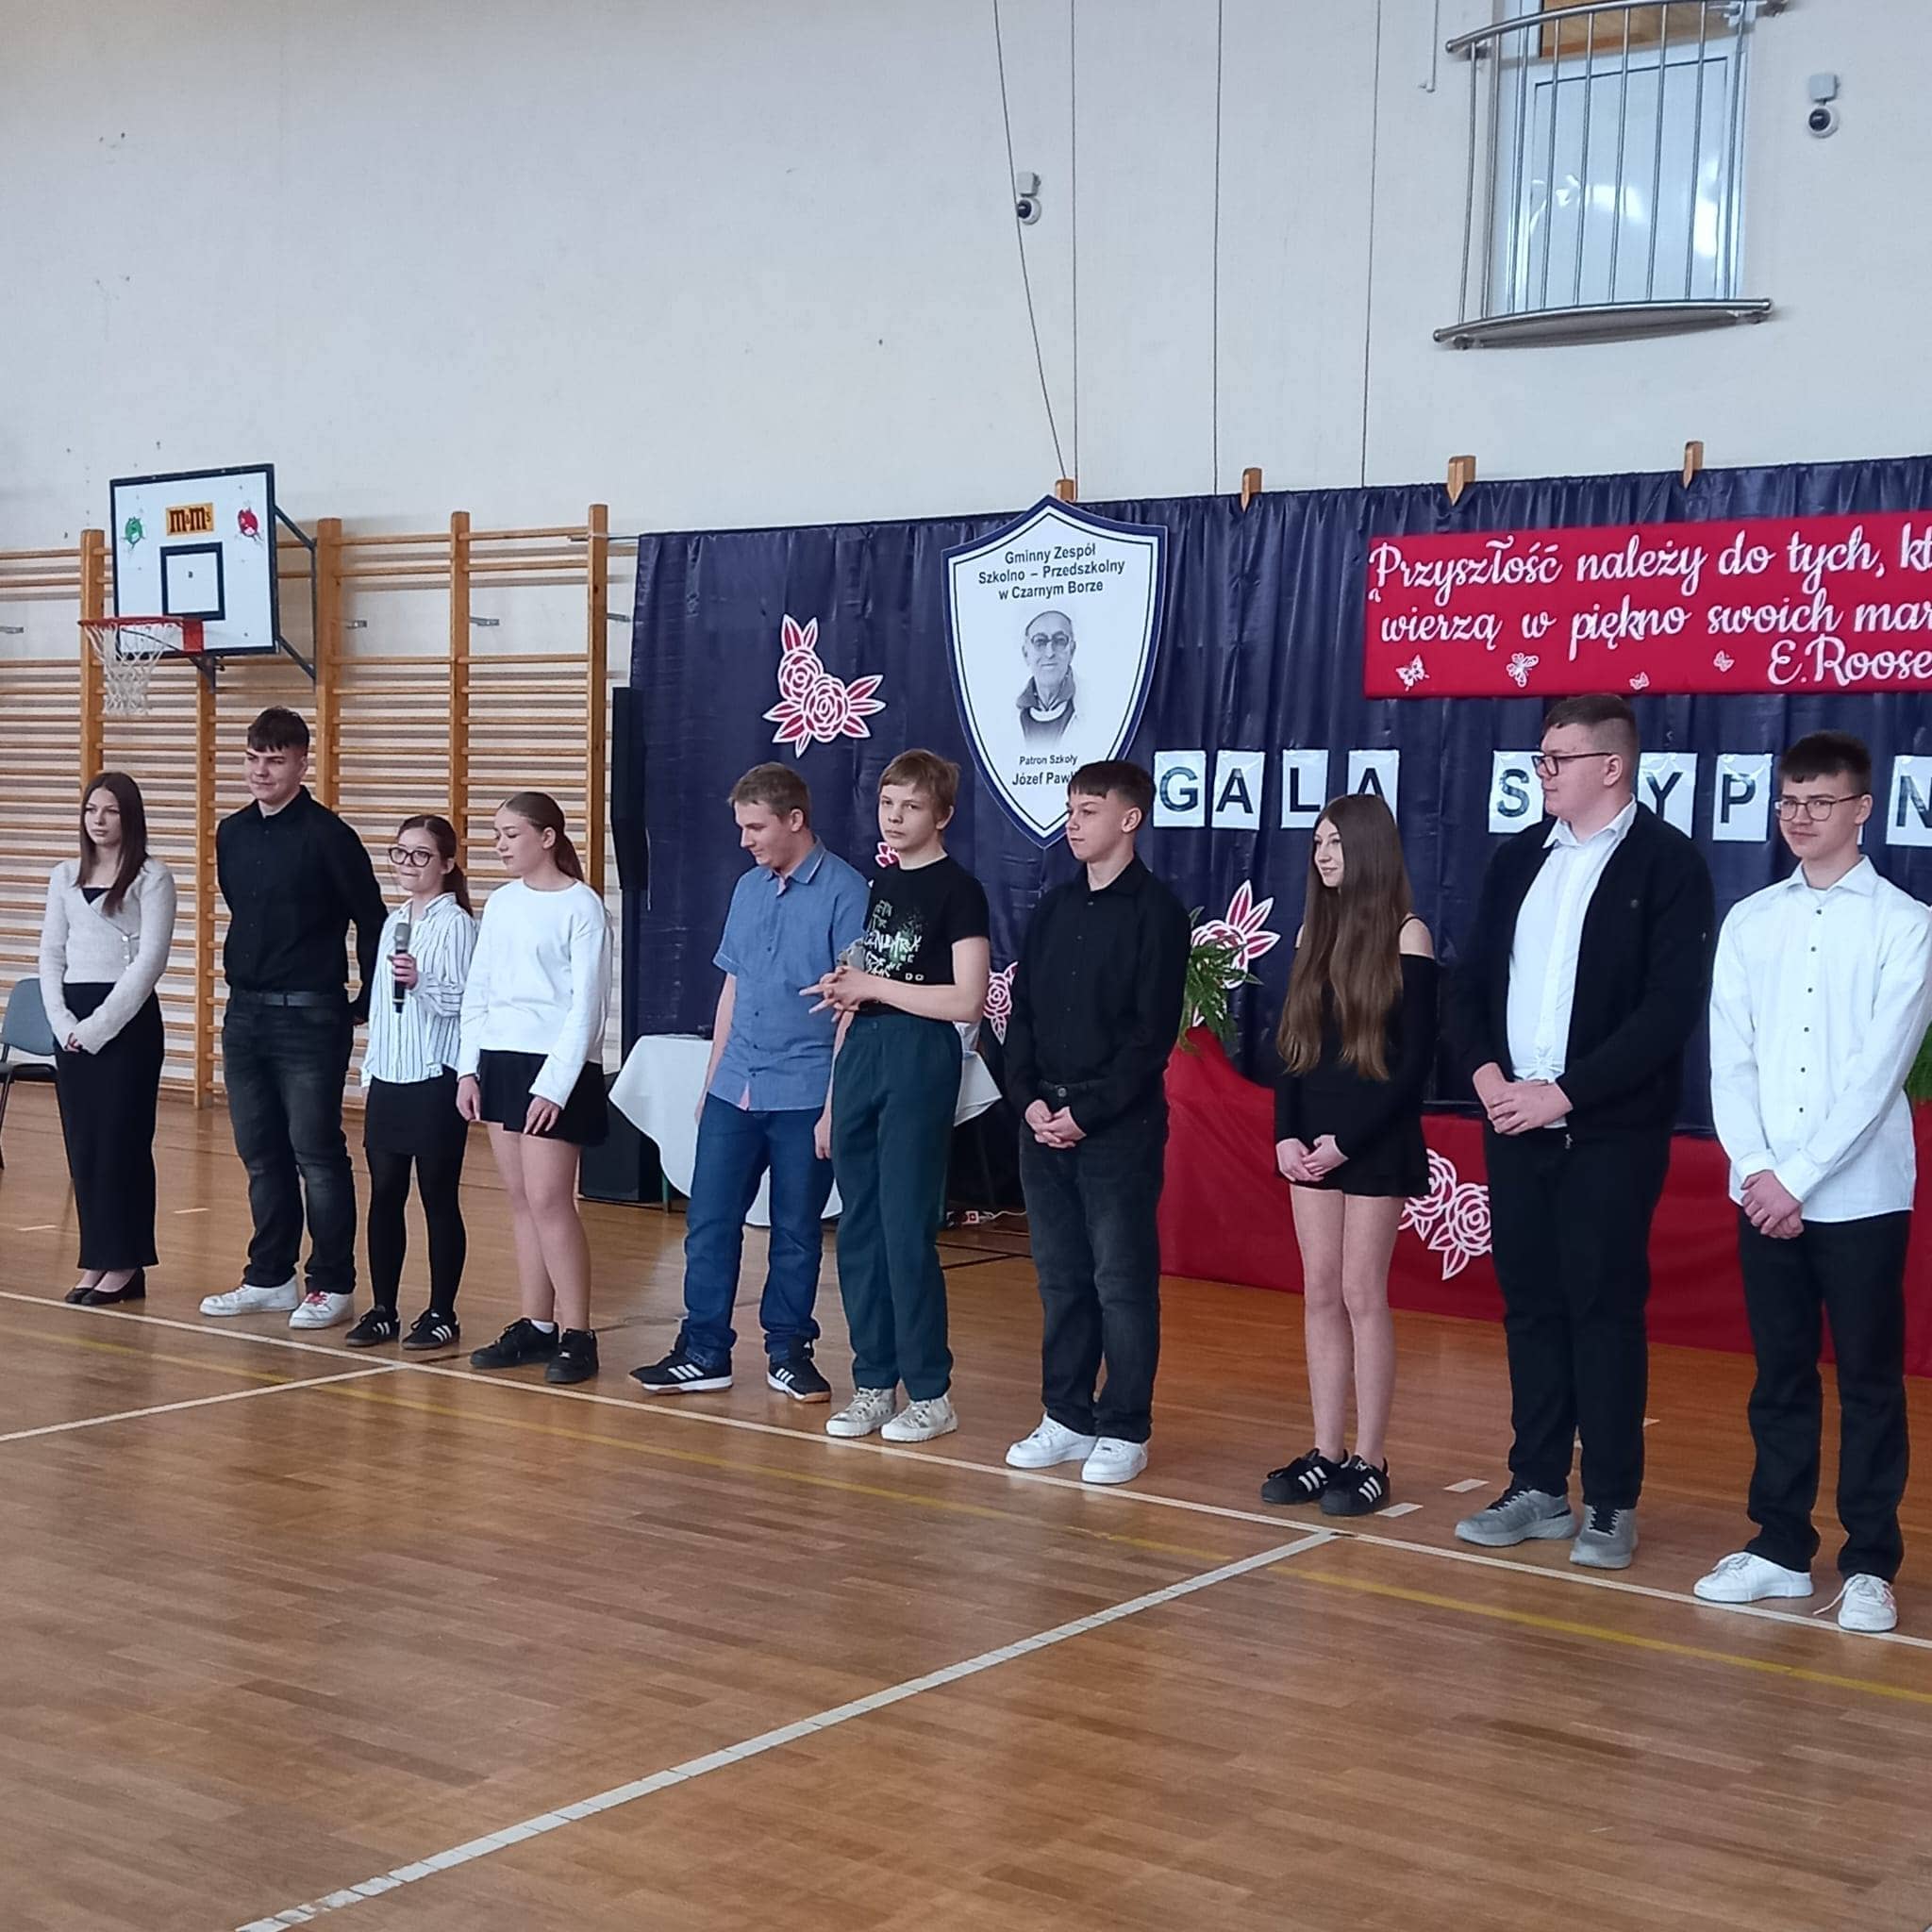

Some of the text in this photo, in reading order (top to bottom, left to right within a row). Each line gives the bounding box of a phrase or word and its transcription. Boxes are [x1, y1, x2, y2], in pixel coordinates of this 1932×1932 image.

[1005, 542, 1096, 564] Gminny Zespół
[978, 569, 1025, 585] Szkolno
[1042, 558, 1125, 578] Przedszkolny
[1368, 535, 1563, 607] Przyszłość
[1575, 534, 1708, 596] należy
[1718, 529, 1776, 575] do
[1787, 525, 1885, 594] tych,
[998, 580, 1104, 600] w Czarnym Borze
[1381, 607, 1503, 651] wierzą
[1521, 611, 1557, 639] w
[1569, 593, 1692, 661] piękno
[1707, 587, 1844, 634] swoich
[1019, 754, 1078, 766] Patron Szkoły
[1012, 771, 1043, 785] Józef
[1158, 766, 1386, 814] GALA
